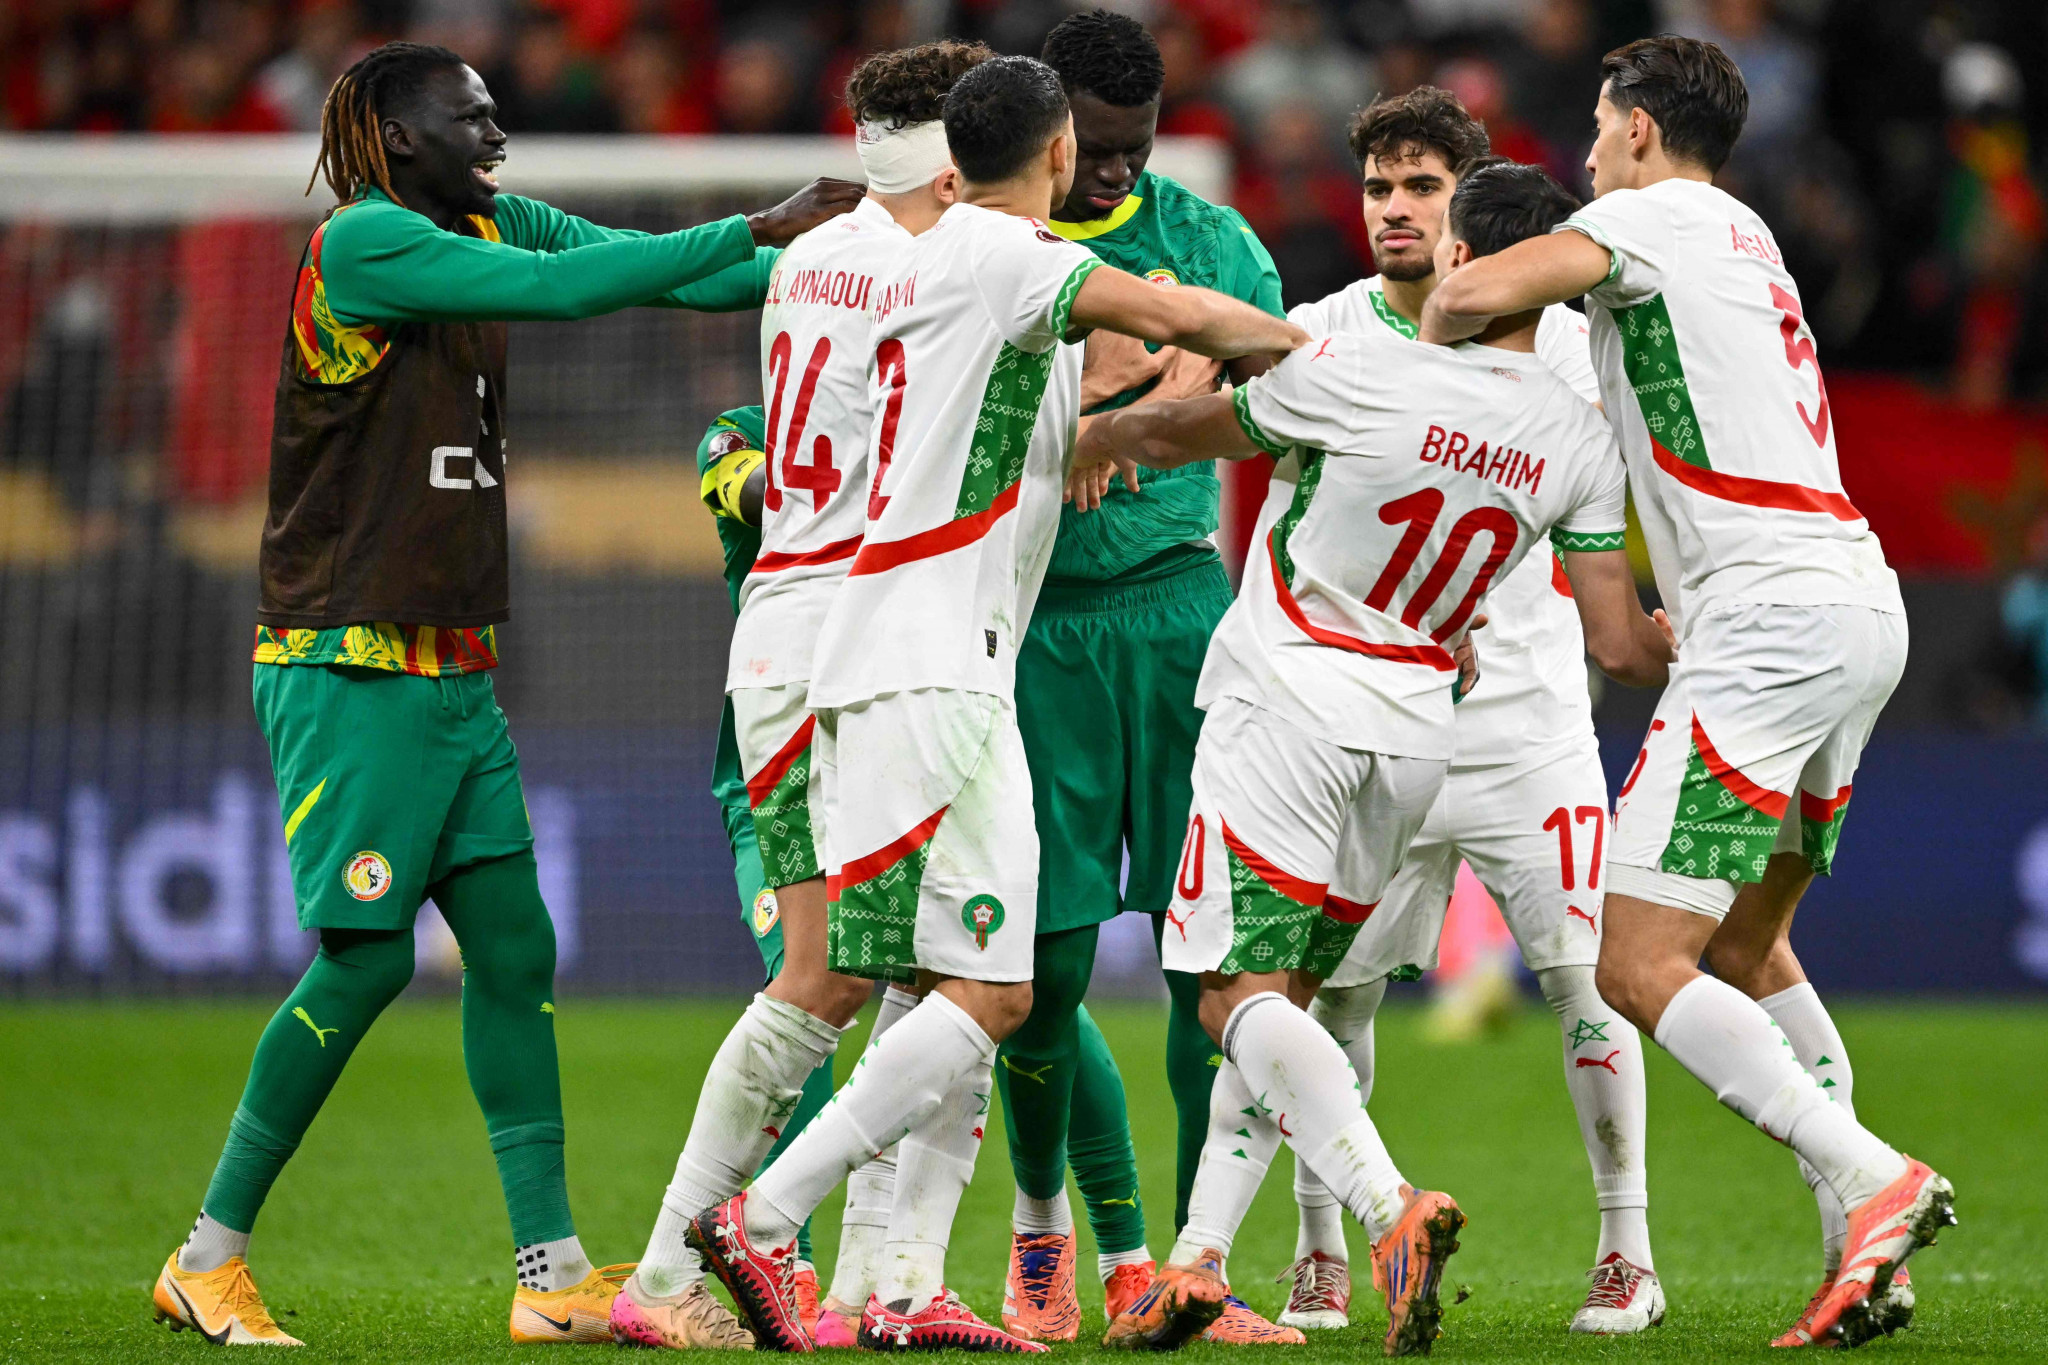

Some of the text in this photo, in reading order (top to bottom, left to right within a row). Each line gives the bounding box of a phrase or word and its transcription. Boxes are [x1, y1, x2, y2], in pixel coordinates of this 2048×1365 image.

[1730, 223, 1785, 266] AGU
[785, 269, 874, 311] AYNAOUI
[1768, 281, 1830, 449] 5
[1419, 424, 1547, 496] BRAHIM
[1364, 487, 1519, 645] 10
[1178, 813, 1206, 901] 0
[1542, 805, 1605, 891] 17
